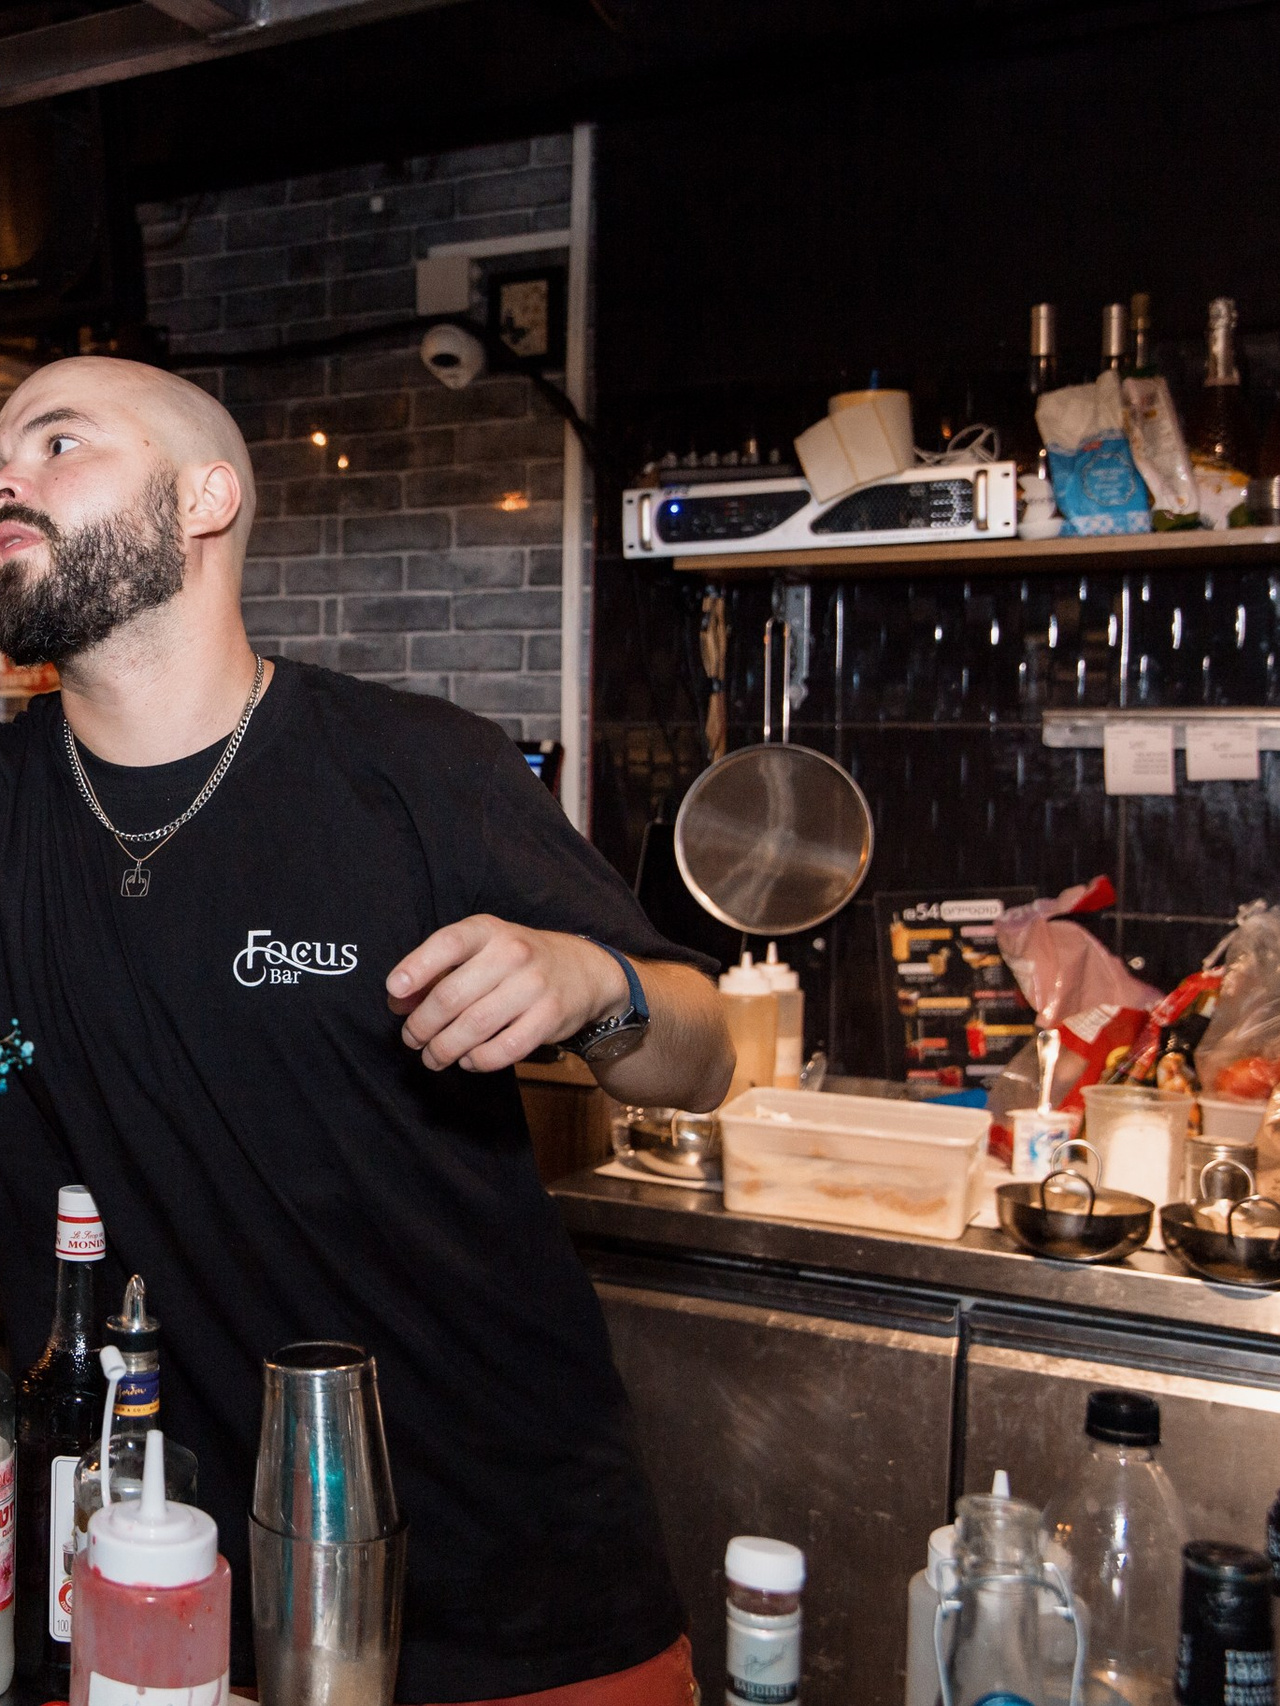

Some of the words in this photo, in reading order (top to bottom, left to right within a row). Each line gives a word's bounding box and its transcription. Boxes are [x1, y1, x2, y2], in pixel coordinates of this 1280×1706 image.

[233, 930, 358, 986] Focus
[269, 968, 322, 984] Bar
[68, 1238, 105, 1249] MONIN
